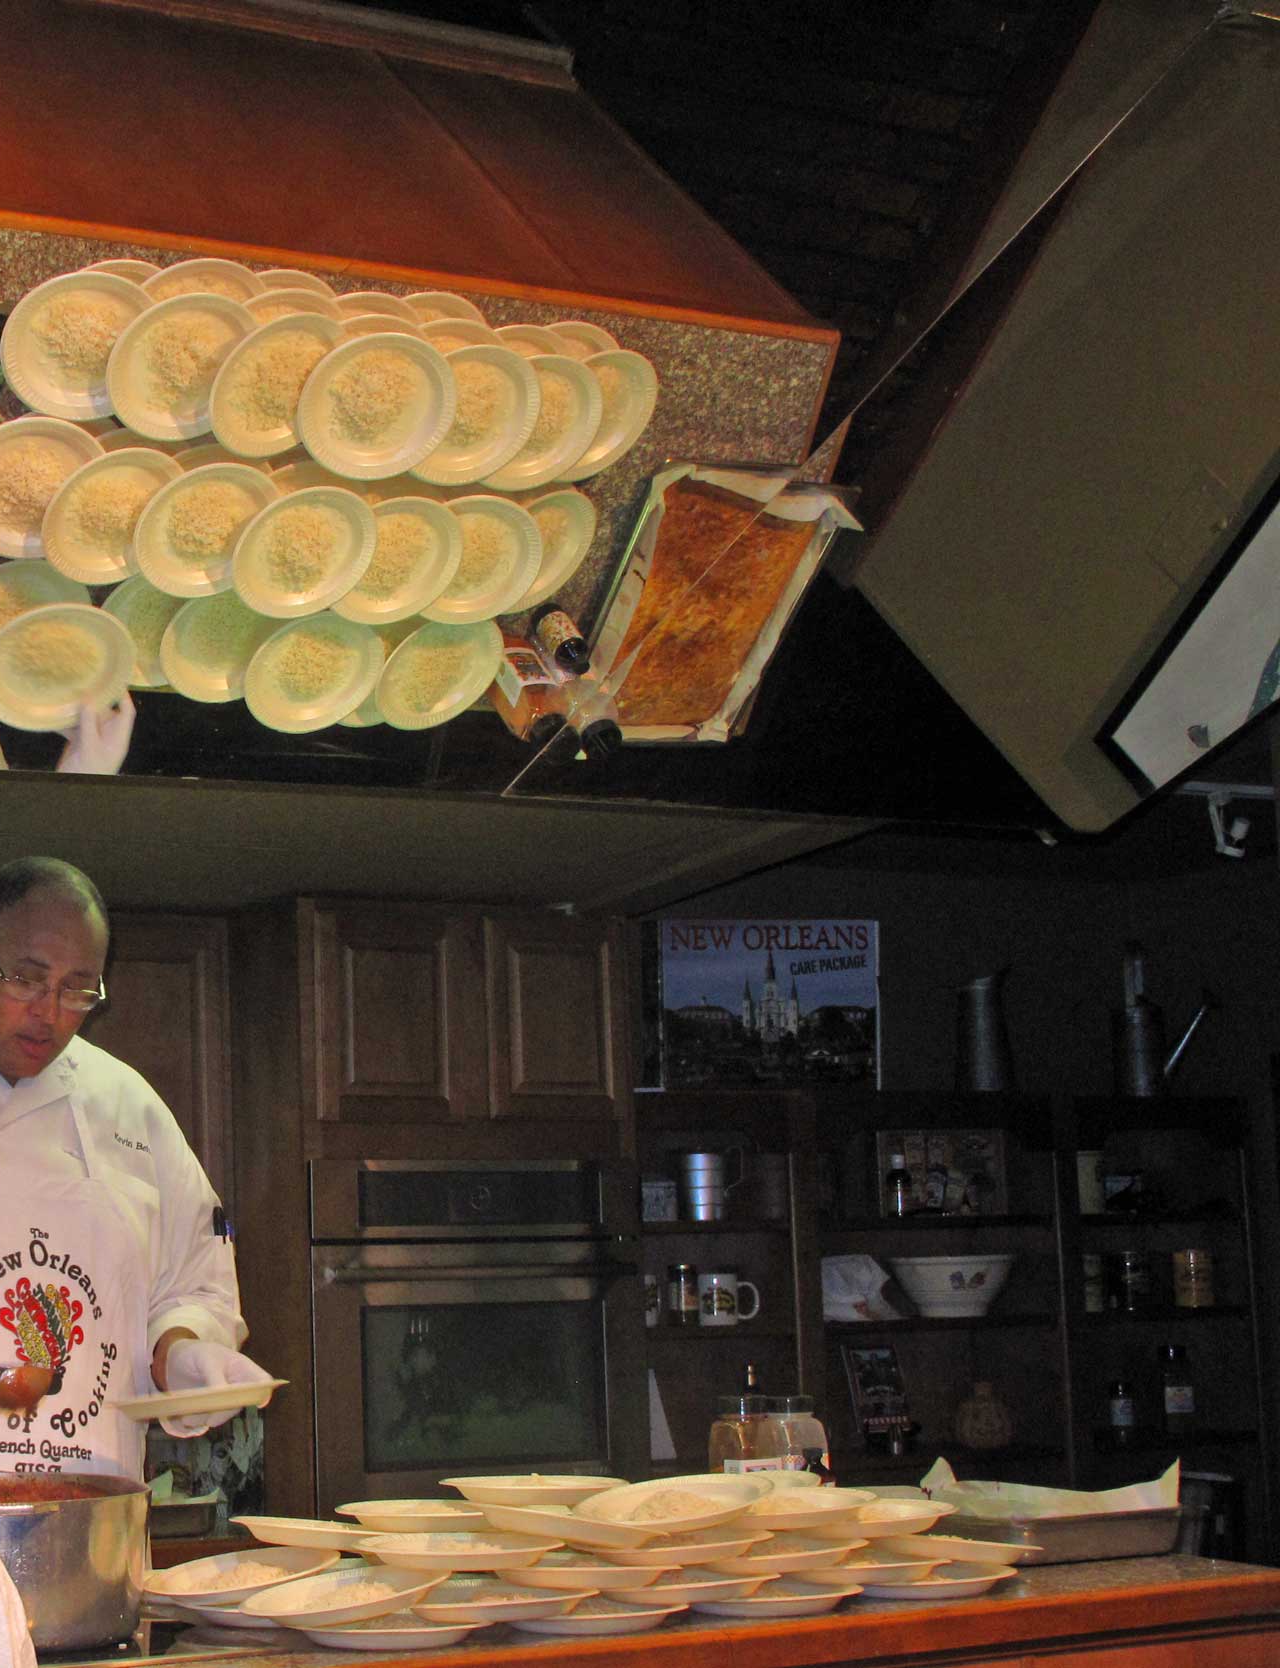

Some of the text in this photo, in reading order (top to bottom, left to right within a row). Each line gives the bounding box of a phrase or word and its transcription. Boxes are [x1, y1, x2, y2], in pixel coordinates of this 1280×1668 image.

[670, 924, 869, 950] NEW ORLEANS
[790, 954, 867, 976] CARE PACKAGE
[29, 1227, 49, 1240] The
[28, 1239, 102, 1320] Orleans
[7, 1407, 38, 1433] of
[50, 1342, 118, 1438] Cooking
[40, 1439, 93, 1462] Quarter
